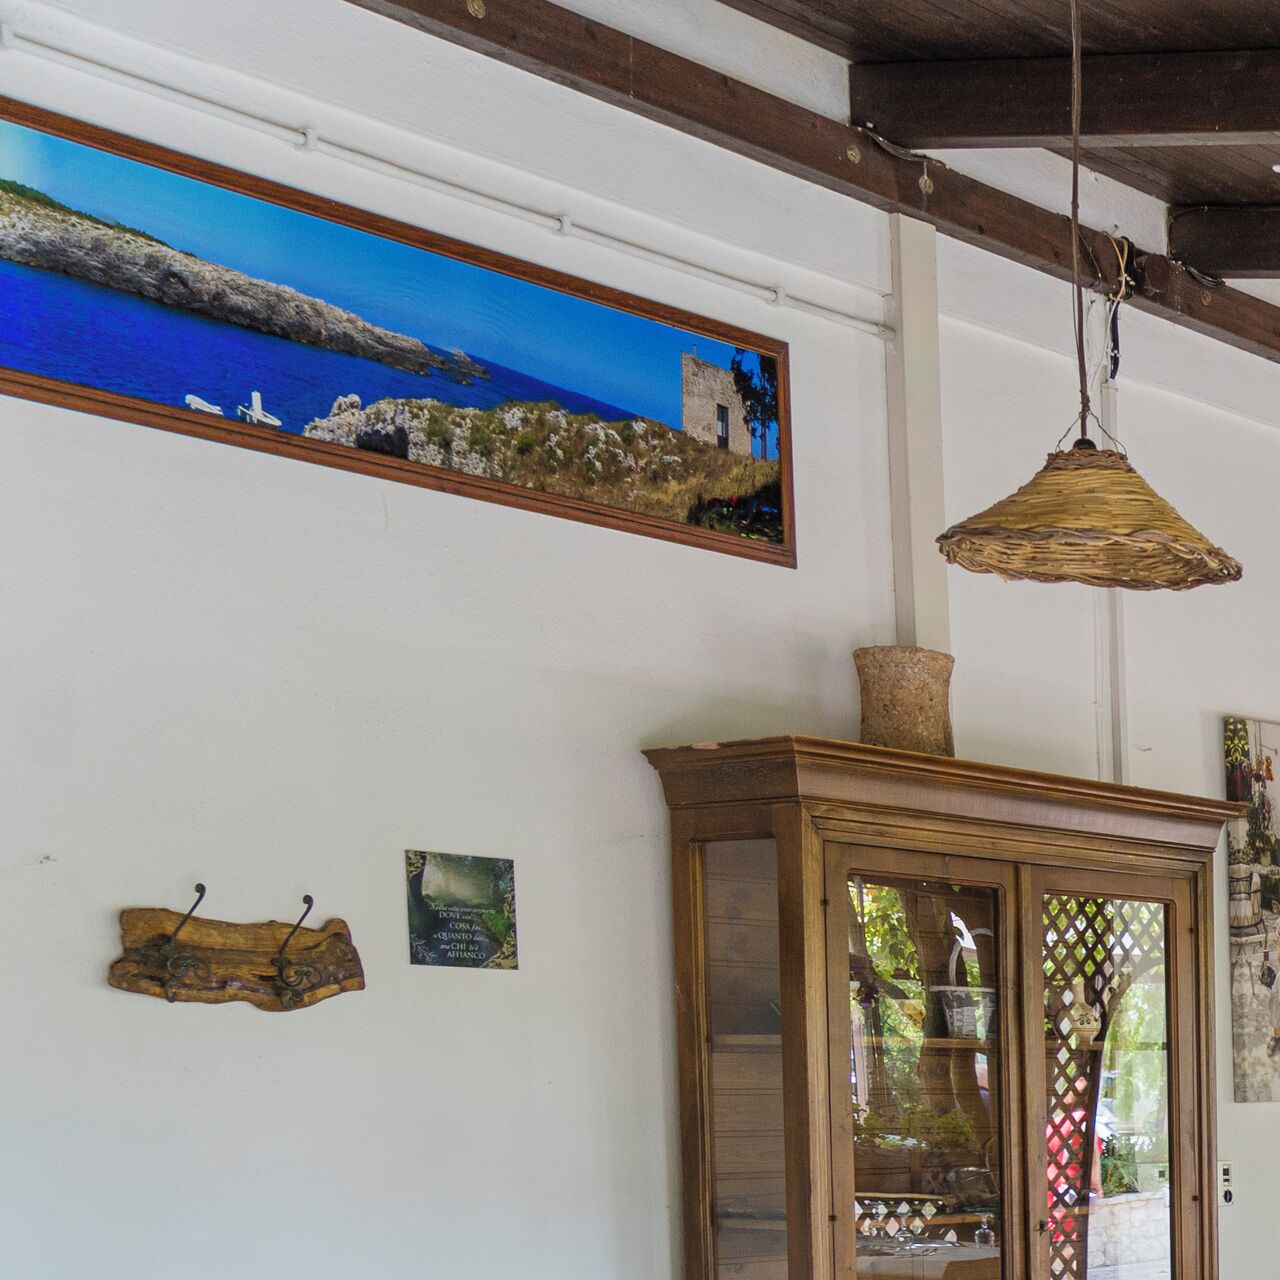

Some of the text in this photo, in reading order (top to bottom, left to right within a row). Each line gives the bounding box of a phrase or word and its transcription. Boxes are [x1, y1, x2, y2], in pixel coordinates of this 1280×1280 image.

[439, 911, 460, 919] DOVE
[449, 922, 471, 930] COSA
[438, 931, 472, 942] QUANTO
[447, 950, 486, 959] AFFIANCO
